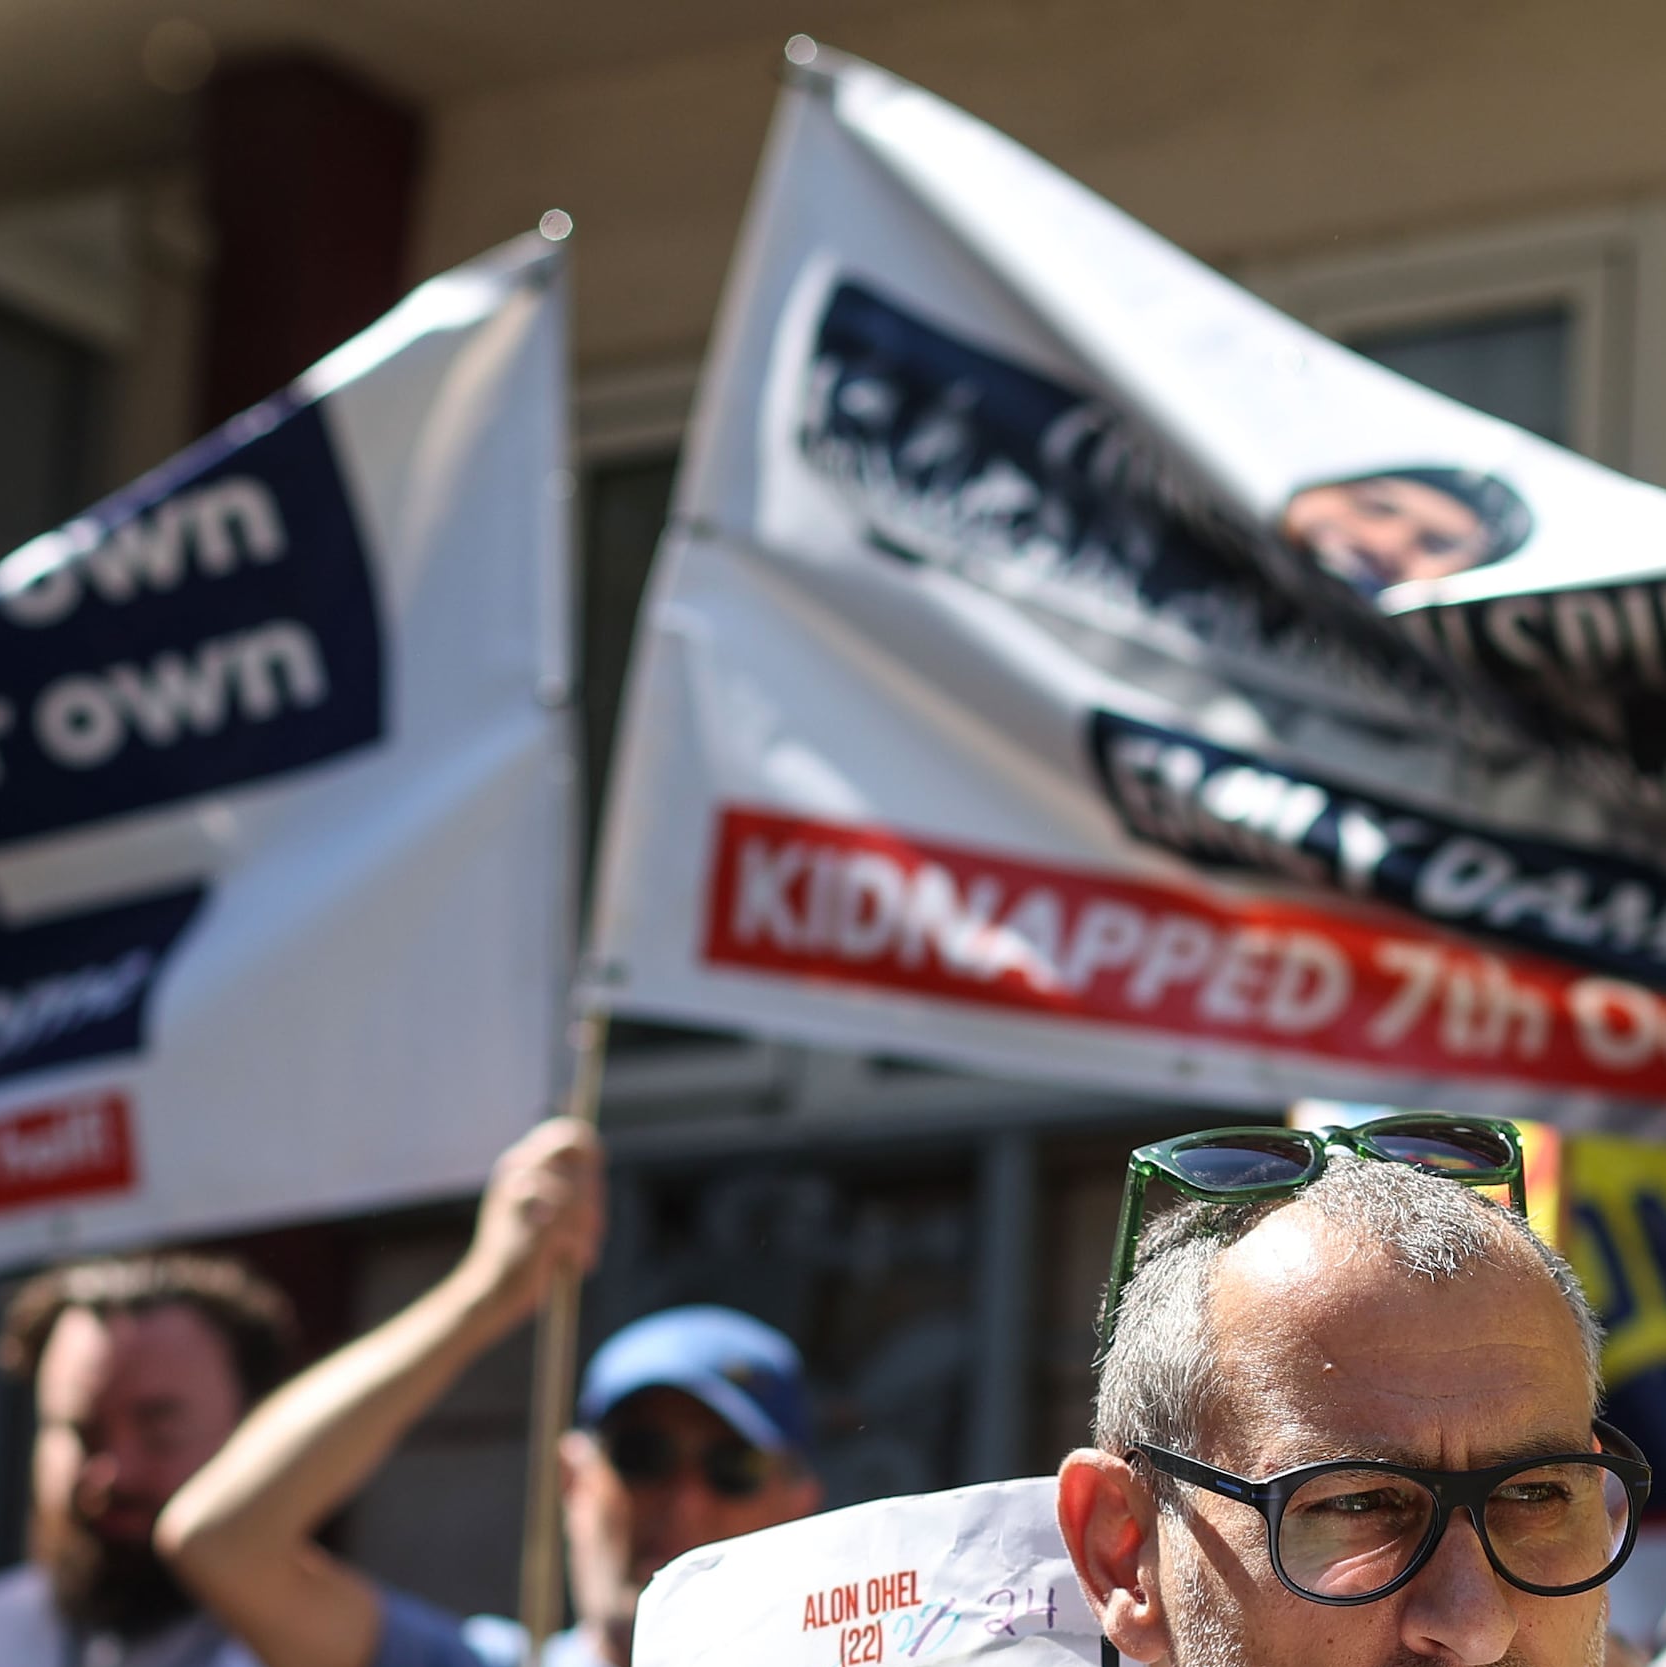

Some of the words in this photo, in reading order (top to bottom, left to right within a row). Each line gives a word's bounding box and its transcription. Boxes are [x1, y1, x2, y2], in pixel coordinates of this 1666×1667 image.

[33, 618, 325, 768] own
[728, 845, 1353, 1037] KIDNAPPED
[1368, 935, 1550, 1052] 7th
[802, 1583, 859, 1632] ALON
[866, 1570, 922, 1616] OHEL
[984, 1586, 1058, 1637] 24
